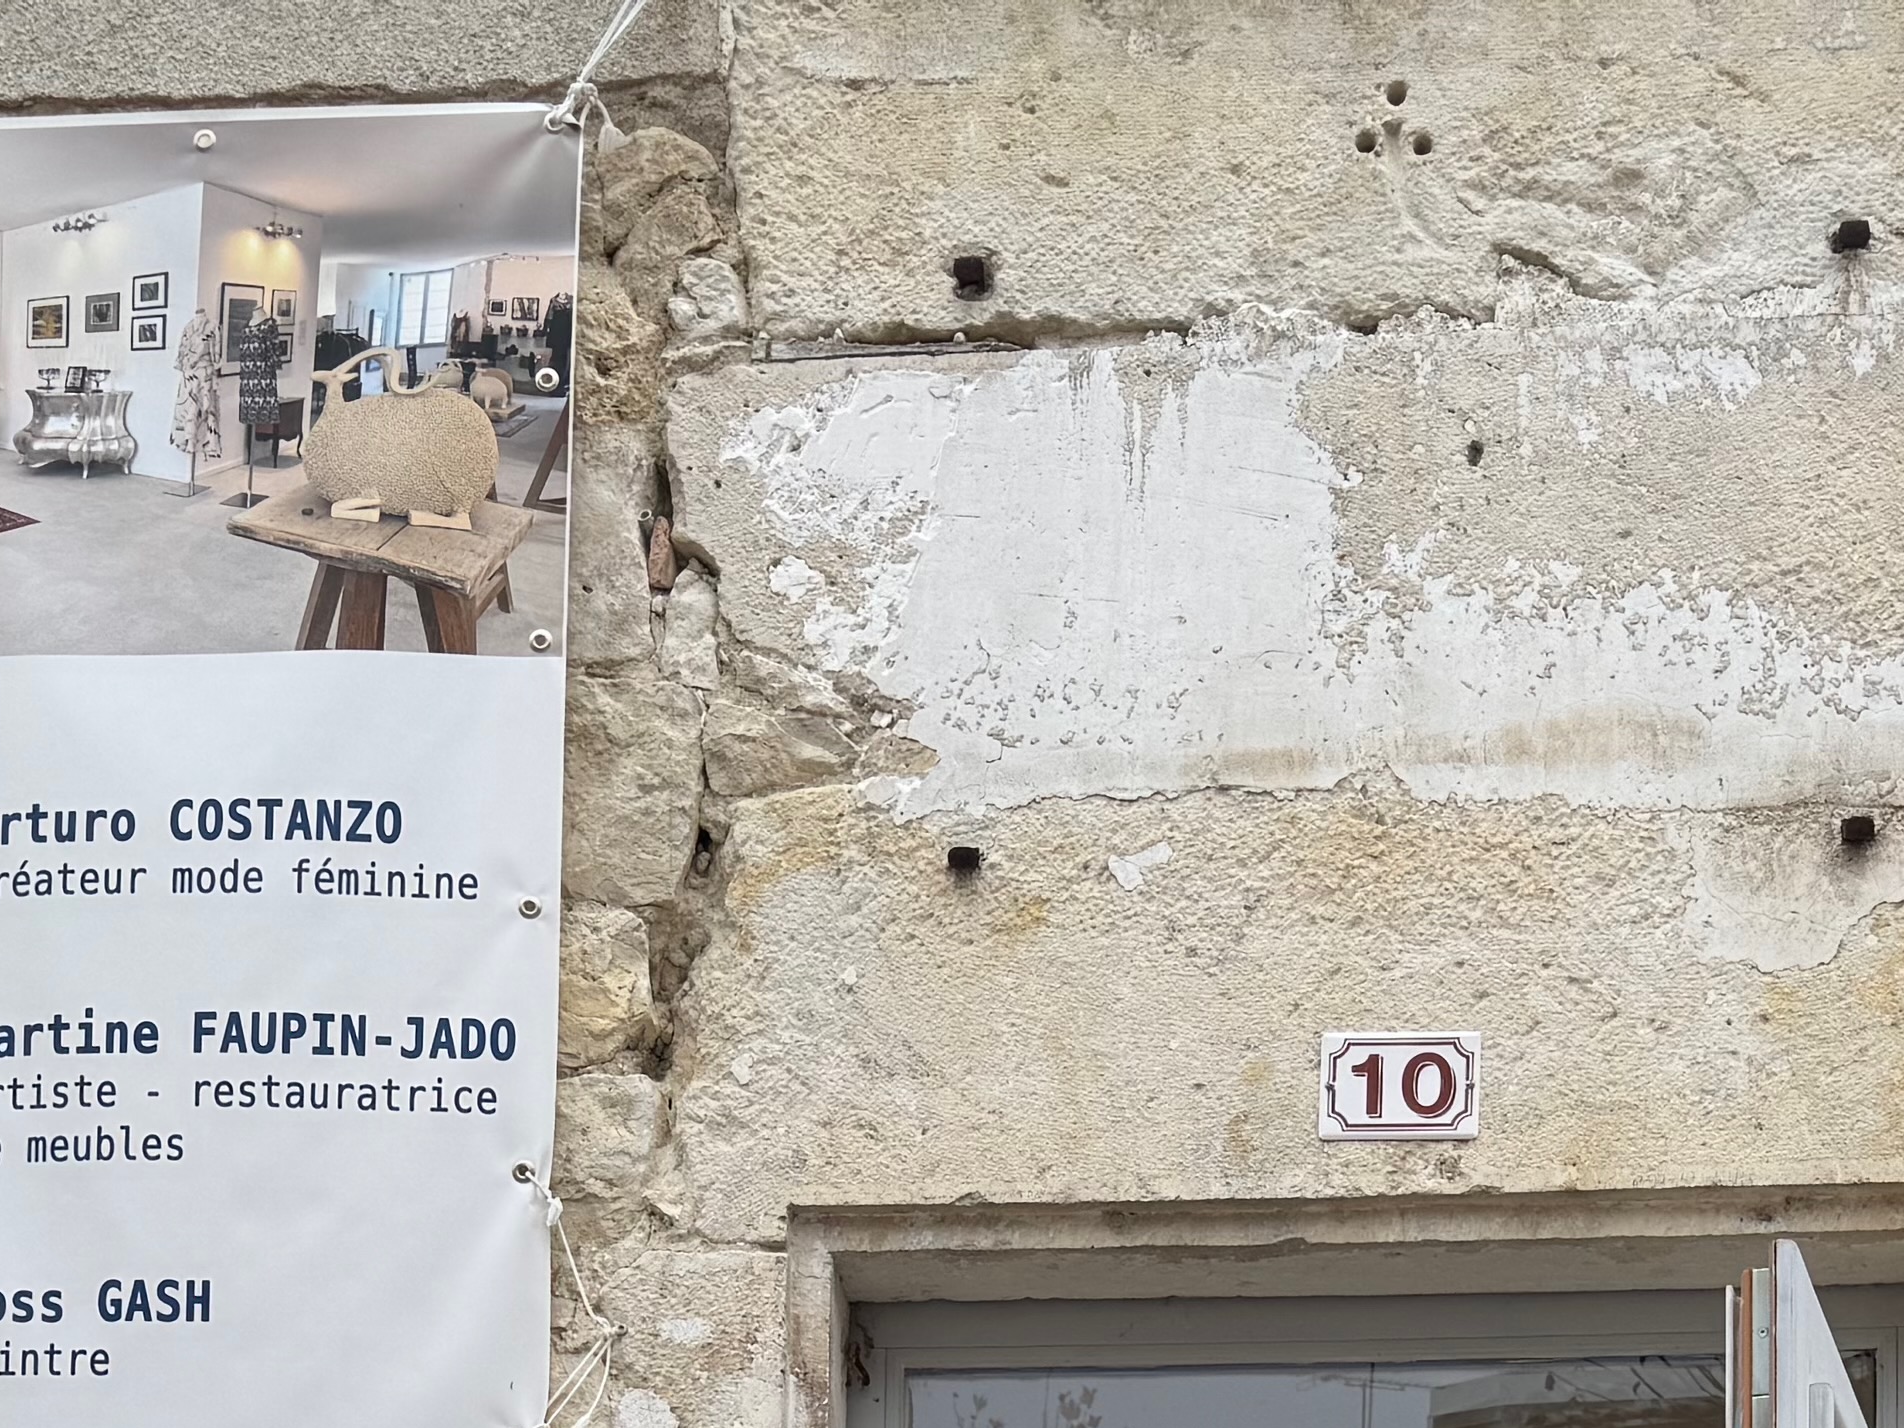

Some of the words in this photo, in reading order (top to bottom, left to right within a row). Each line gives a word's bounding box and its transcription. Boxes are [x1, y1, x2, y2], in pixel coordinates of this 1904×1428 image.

[169, 797, 402, 845] COSTANZO
[172, 858, 263, 894] mode
[291, 858, 479, 900] féminine
[193, 1011, 516, 1062] FAUPIN-JADO
[194, 1074, 497, 1115] restauratrice
[1351, 1050, 1459, 1120] 10
[27, 1126, 184, 1163] meubles
[97, 1278, 211, 1323] GASH
